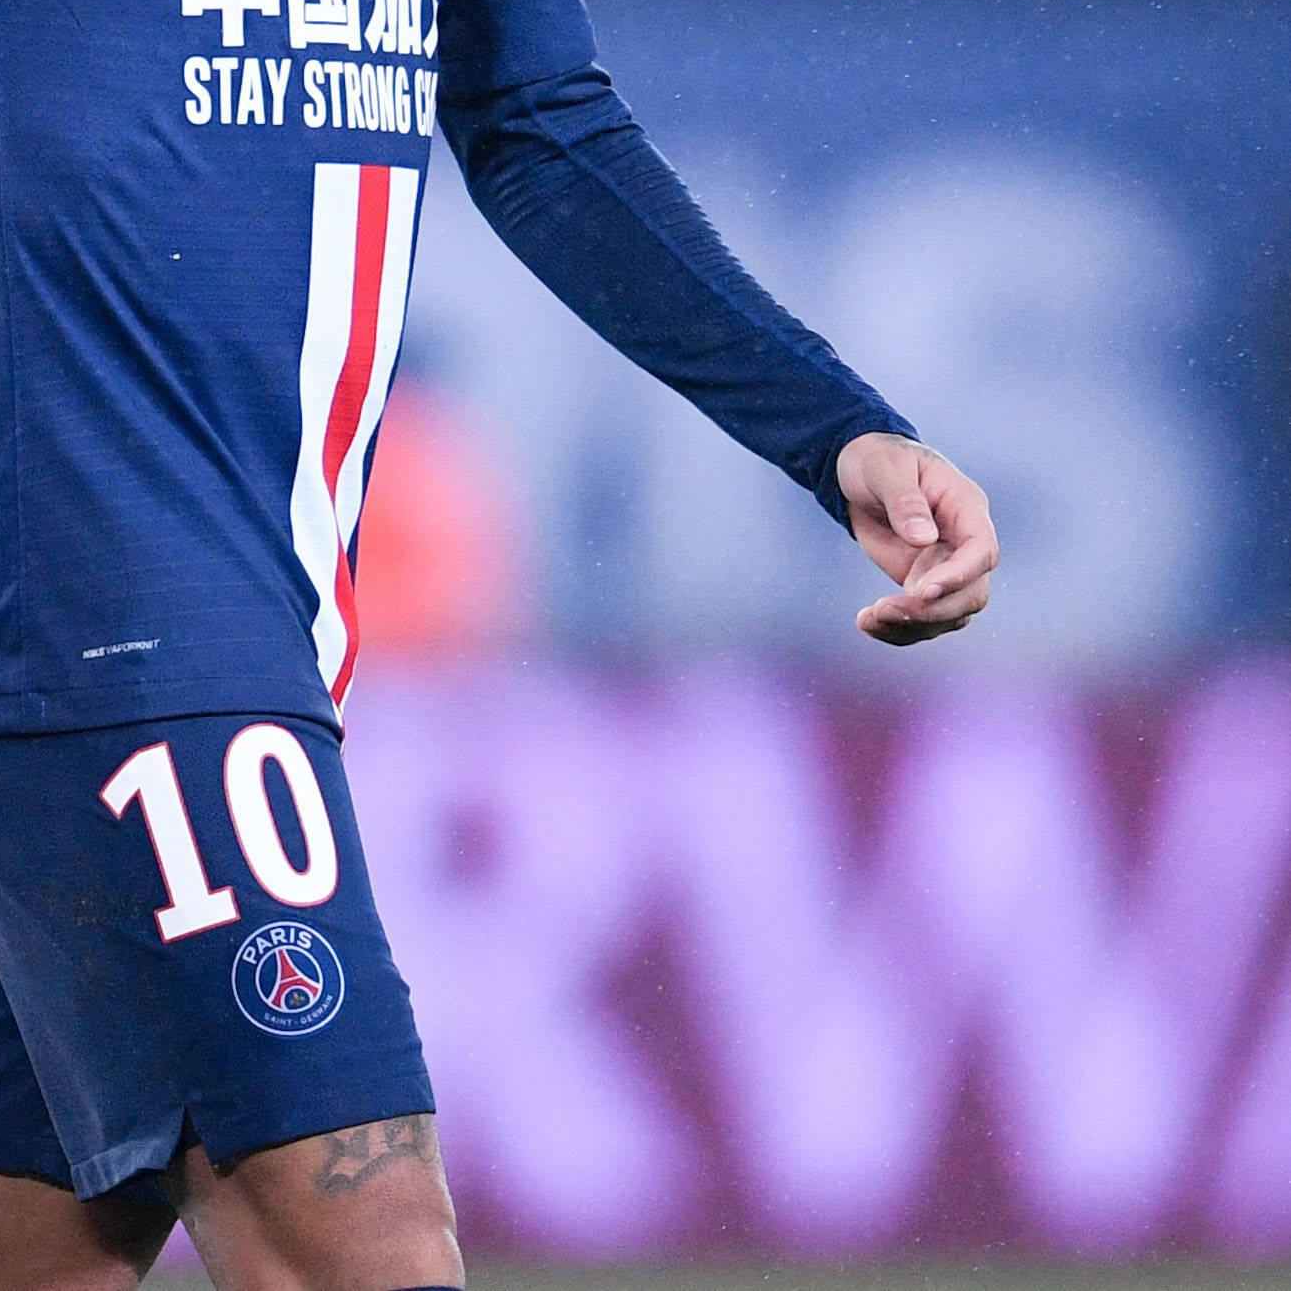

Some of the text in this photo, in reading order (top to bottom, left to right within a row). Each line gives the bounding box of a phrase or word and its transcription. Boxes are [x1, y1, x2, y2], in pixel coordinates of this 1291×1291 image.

[183, 56, 292, 125] STAY
[303, 59, 411, 134] STRONG
[99, 721, 341, 944] 10
[242, 927, 314, 965] PARIS
